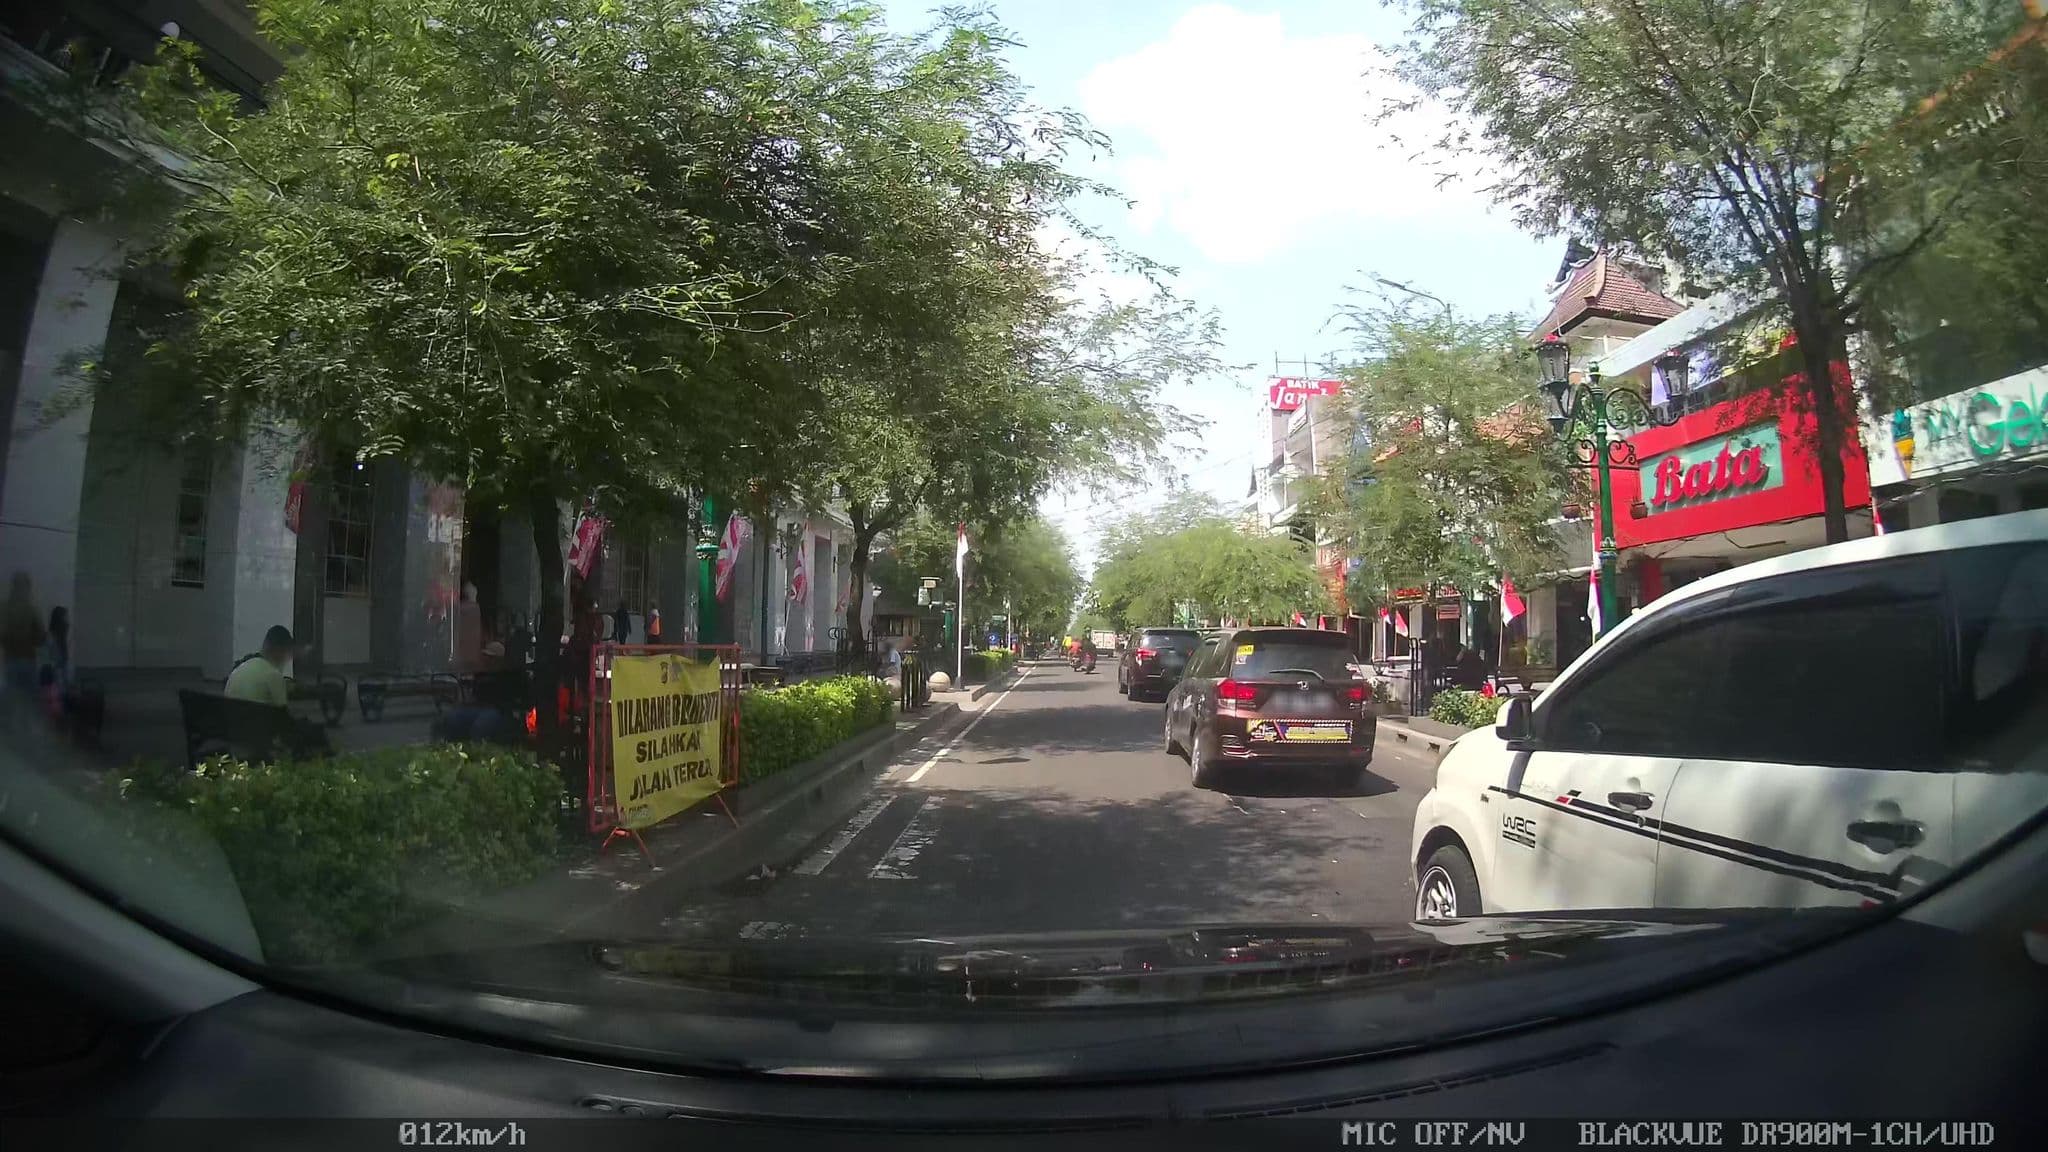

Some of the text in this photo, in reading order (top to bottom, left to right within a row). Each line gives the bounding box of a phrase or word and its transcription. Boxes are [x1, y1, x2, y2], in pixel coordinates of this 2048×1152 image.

[1286, 380, 1320, 389] BATIK
[1652, 440, 1767, 508] Bata
[1502, 813, 1536, 837] WRC
